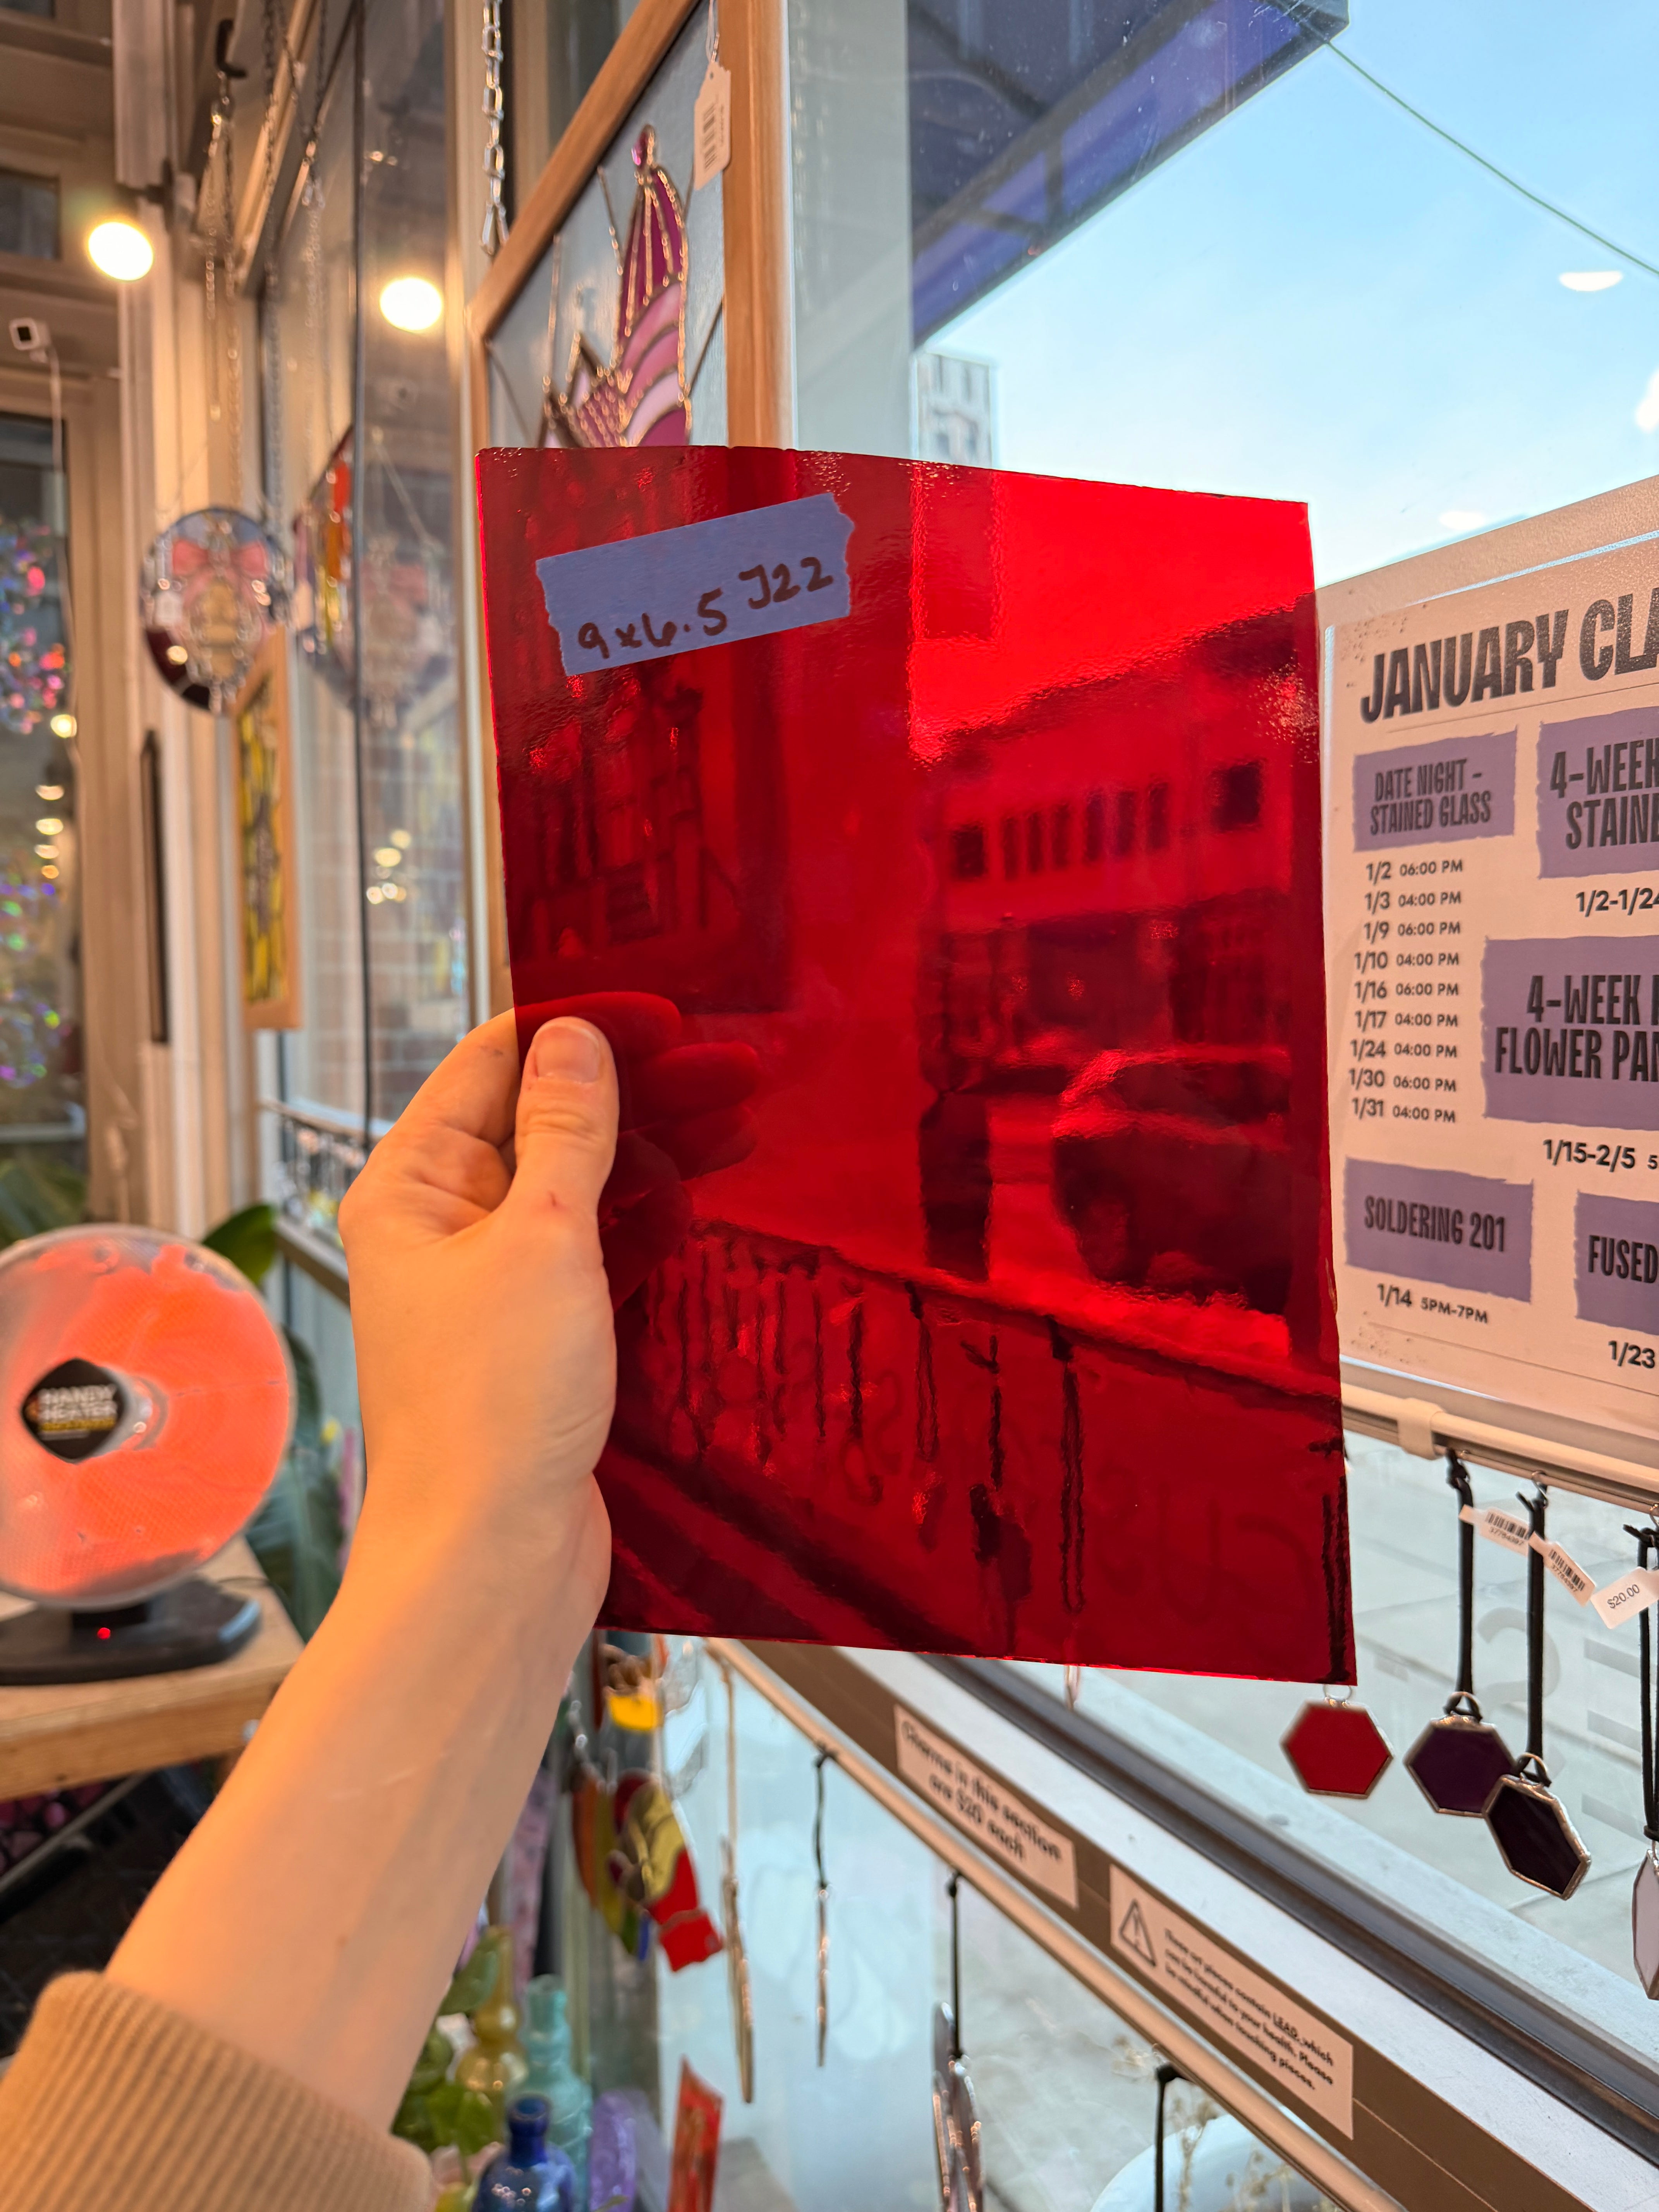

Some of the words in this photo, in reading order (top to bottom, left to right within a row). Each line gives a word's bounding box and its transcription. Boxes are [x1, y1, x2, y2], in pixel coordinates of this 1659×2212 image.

[578, 588, 727, 659] 9x6.5
[738, 556, 833, 609] J22
[1360, 610, 1569, 724] JANUARY
[1374, 767, 1413, 801] DATE
[1417, 759, 1468, 795] NIGHT
[1370, 799, 1433, 835] STAINED
[1438, 790, 1491, 827] GLASS
[1366, 862, 1391, 885] 1/2
[1400, 862, 1436, 876] 06:00
[1443, 860, 1462, 872] PM
[1365, 891, 1390, 914] 1/3
[1399, 893, 1435, 907] 04:00
[1441, 891, 1461, 904] PM
[1364, 921, 1389, 944] 1/9
[1398, 923, 1434, 936] 06:00
[1440, 922, 1460, 934] PM
[1355, 951, 1388, 974] 1/10
[1397, 953, 1433, 966] 04:00
[1439, 953, 1459, 965] PM
[1355, 981, 1387, 1003] 1/16
[1396, 983, 1432, 995] 06:00
[1438, 984, 1458, 995] PM
[1527, 975, 1641, 1025] 4-WEEK
[1355, 1010, 1387, 1032] 1/17
[1395, 1013, 1431, 1026] 04:00
[1437, 1015, 1458, 1027] PM
[1351, 1039, 1386, 1061] 1/24
[1395, 1043, 1431, 1056] 04:00
[1437, 1045, 1456, 1057] PM
[1496, 1027, 1602, 1079] FLOWER
[1349, 1068, 1385, 1090] 1/30
[1394, 1076, 1430, 1089] 06:00
[1436, 1079, 1456, 1092] PM
[1352, 1097, 1384, 1119] 1/31
[1393, 1105, 1429, 1120] 04:00
[1435, 1109, 1455, 1122] PM
[1544, 1140, 1635, 1172] 1/15-2/5
[1364, 1195, 1463, 1245] SOLDERING
[1470, 1212, 1505, 1252] 201
[1589, 1235, 1658, 1283] FUSED
[1378, 1284, 1412, 1307] 1/14
[1420, 1297, 1488, 1324] 5PM-7PM
[1609, 1341, 1655, 1369] 1/23
[1607, 1584, 1640, 1609] $20.00
[1300, 2037, 1333, 2066] which
[1279, 2057, 1315, 2090] pieces.
[1299, 2051, 1333, 2085] Please
